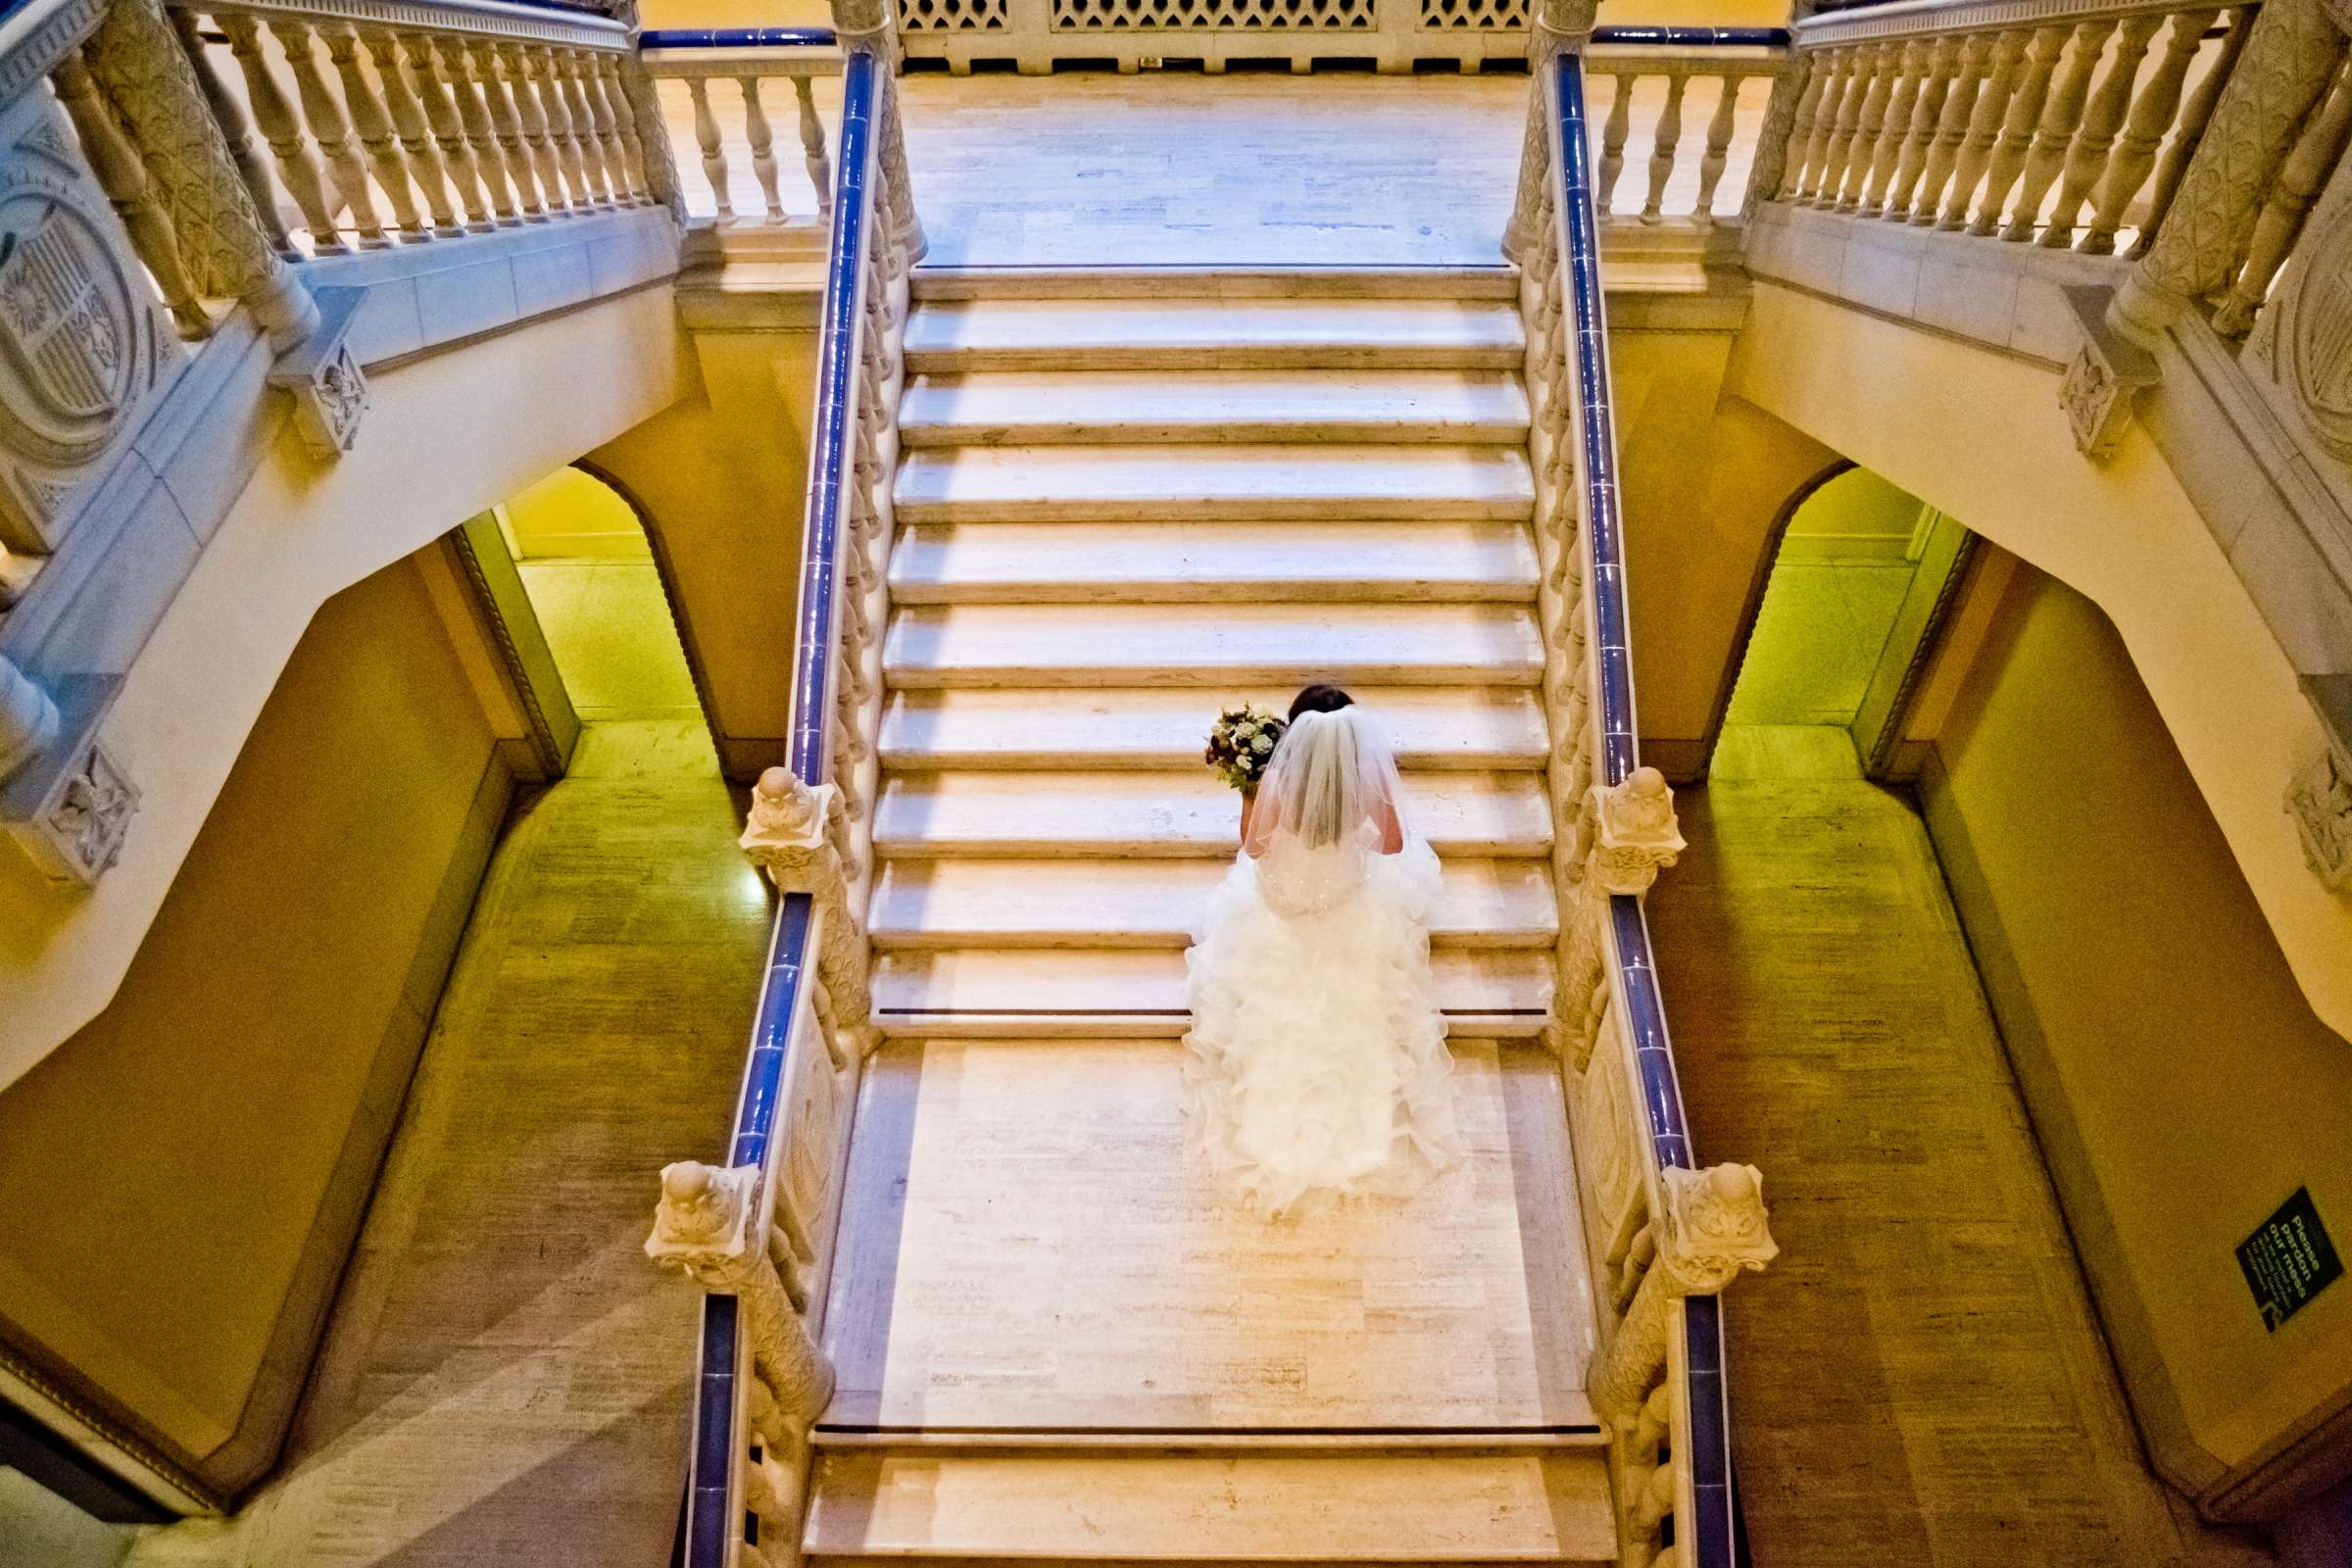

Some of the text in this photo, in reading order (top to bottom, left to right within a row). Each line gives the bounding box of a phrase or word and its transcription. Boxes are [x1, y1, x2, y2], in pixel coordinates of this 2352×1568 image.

[2270, 1224, 2285, 1249] our
[2283, 1253, 2306, 1298] mess
[2281, 1223, 2311, 1281] pardon
[2292, 1215, 2320, 1271] Please
